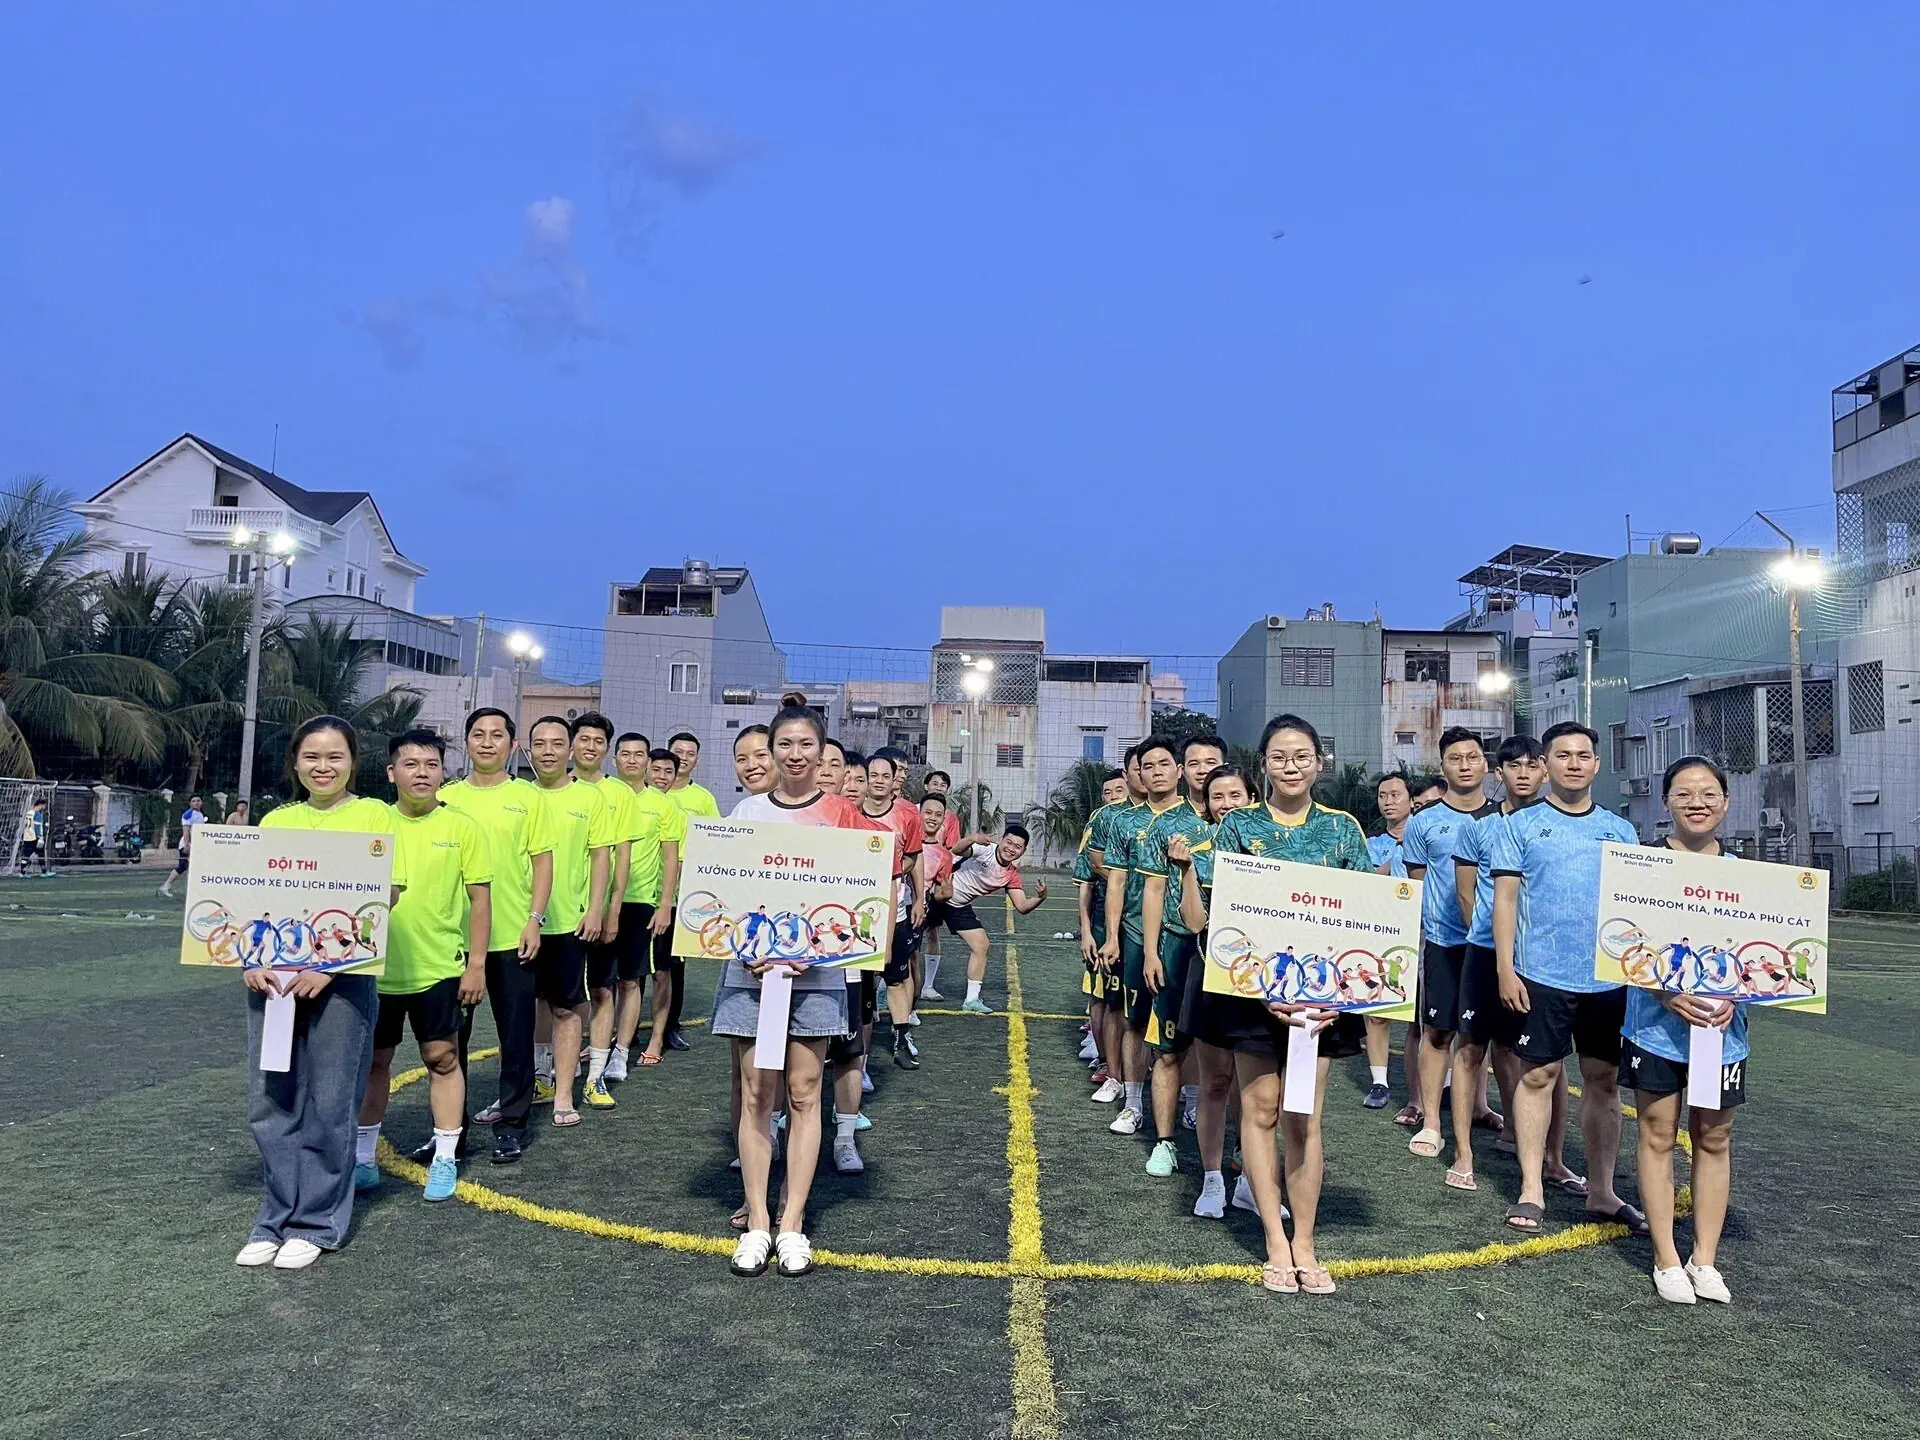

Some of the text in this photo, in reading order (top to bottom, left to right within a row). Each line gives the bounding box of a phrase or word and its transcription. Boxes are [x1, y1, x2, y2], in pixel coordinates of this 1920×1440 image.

[201, 831, 260, 840] THACO AUTO
[693, 824, 754, 834] THACO AUTO
[267, 856, 318, 872] ĐỘI THI
[763, 853, 815, 869] ĐỘI THI
[1221, 857, 1281, 872] THACO AUTO
[1609, 850, 1674, 865] THACO AUTO
[200, 875, 381, 893] SHOWROOM XE DU LỊCH BÌNH ĐỊNH
[697, 864, 877, 887] XƯỞNG DV XE DU LỊCH QUY NHƠN
[1291, 891, 1342, 909] ĐỘI THI
[1683, 885, 1740, 904] ĐỘI THI
[1613, 892, 1811, 928] SHOWROOM KIA, MAZDA PHÙ CÁT
[1230, 903, 1401, 936] SHOWROOM TẢI, BUS BÌNH ĐỊNH
